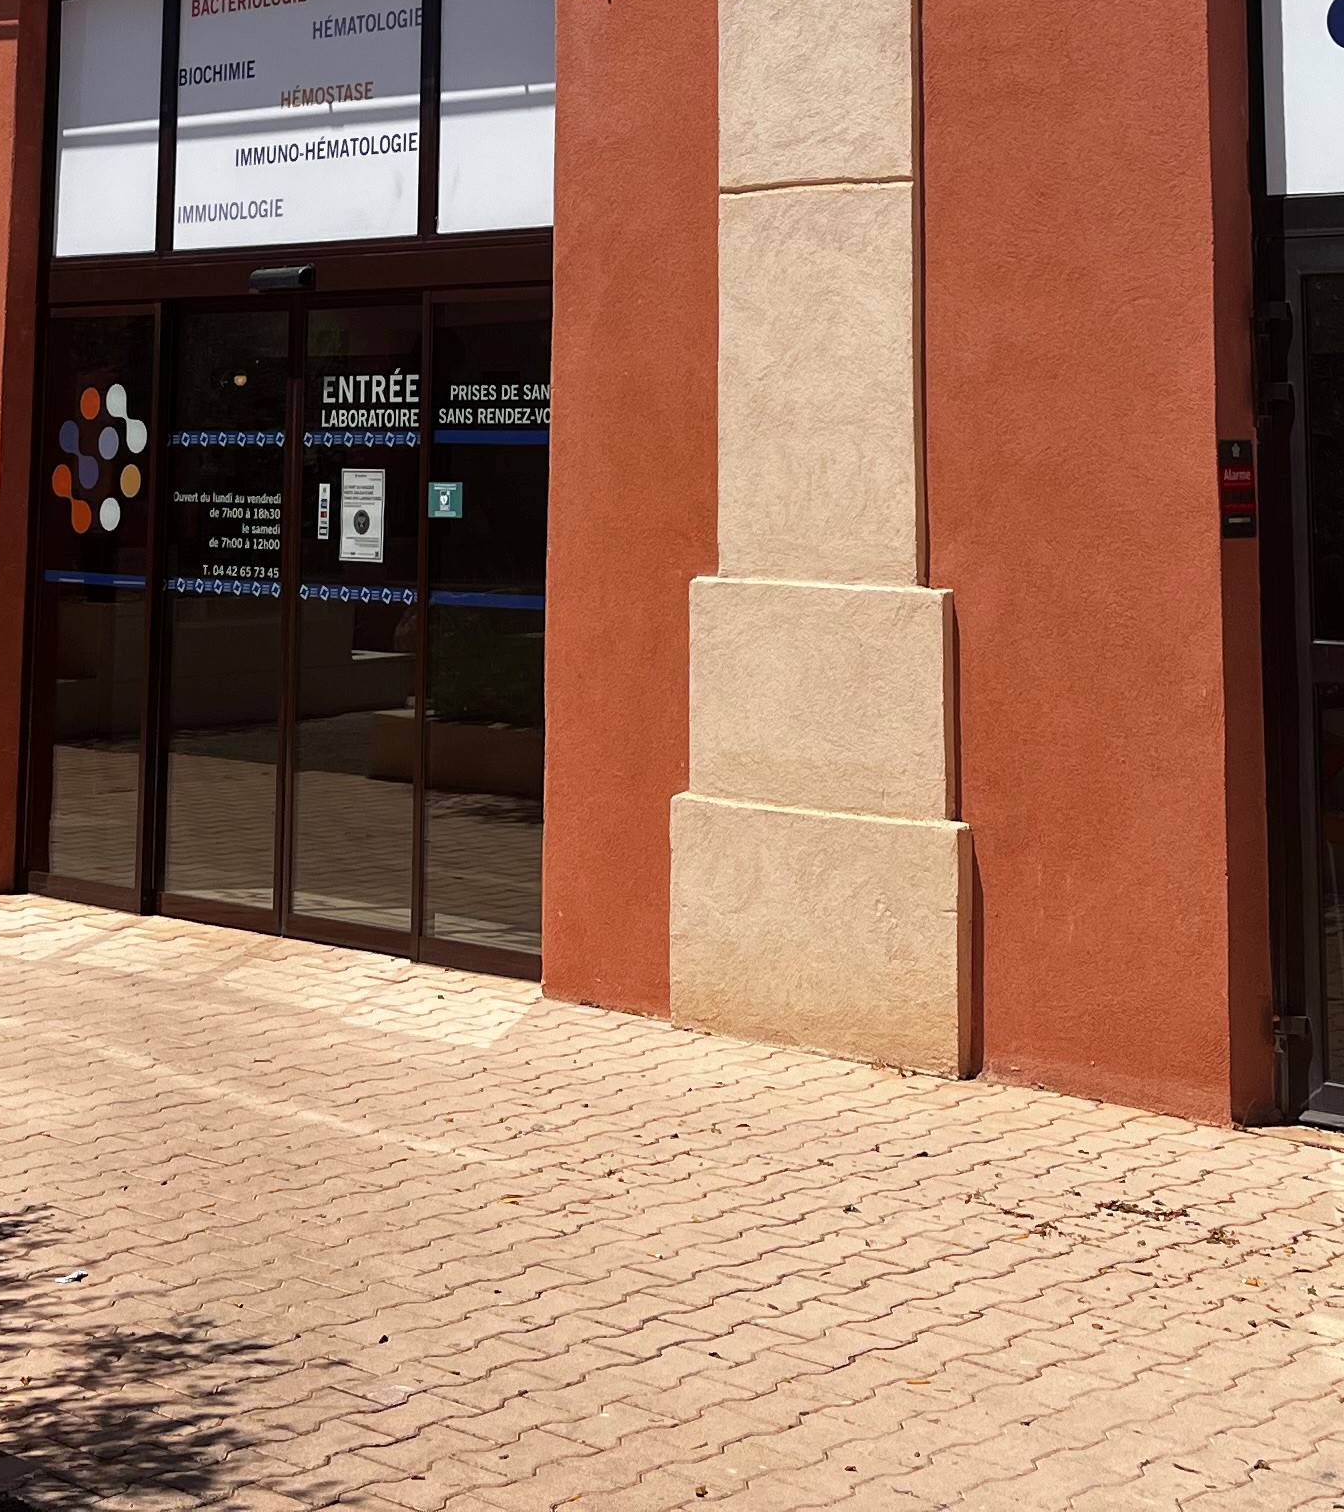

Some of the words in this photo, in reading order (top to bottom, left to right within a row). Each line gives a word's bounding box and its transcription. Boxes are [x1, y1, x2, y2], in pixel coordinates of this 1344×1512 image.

[312, 7, 423, 40] HÉMATOLOGIE
[178, 60, 256, 87] BIOCHIMIE
[280, 81, 374, 109] HÉMOSTASE
[235, 132, 418, 167] IMMUNO-HÉMATOLOGIE
[177, 198, 284, 224] IMMUNOLOGIE
[322, 368, 420, 404] ENTRÉE
[450, 385, 497, 402] PRISES
[501, 385, 519, 401] DE
[321, 409, 420, 428] LABORATOIRE
[438, 408, 473, 424] SANS
[1223, 468, 1251, 482] Alarme
[173, 491, 198, 503] Ouvert
[200, 491, 210, 503] du
[212, 491, 233, 503] lundi
[235, 494, 245, 504] au
[247, 493, 282, 504] vendredi
[209, 507, 219, 518] de
[222, 508, 243, 519] 7h00
[245, 508, 250, 519] à
[253, 508, 281, 519] 18h30
[242, 523, 249, 534] le
[252, 523, 281, 535] samedi
[208, 537, 219, 548] de
[221, 537, 243, 549] 7h00
[245, 538, 250, 549] à
[253, 538, 280, 550] 12h00
[203, 564, 211, 576] T.
[213, 564, 224, 576] 04
[225, 565, 238, 577] 42
[240, 566, 251, 577] 65
[253, 566, 265, 578] 73
[267, 567, 279, 579] 45
